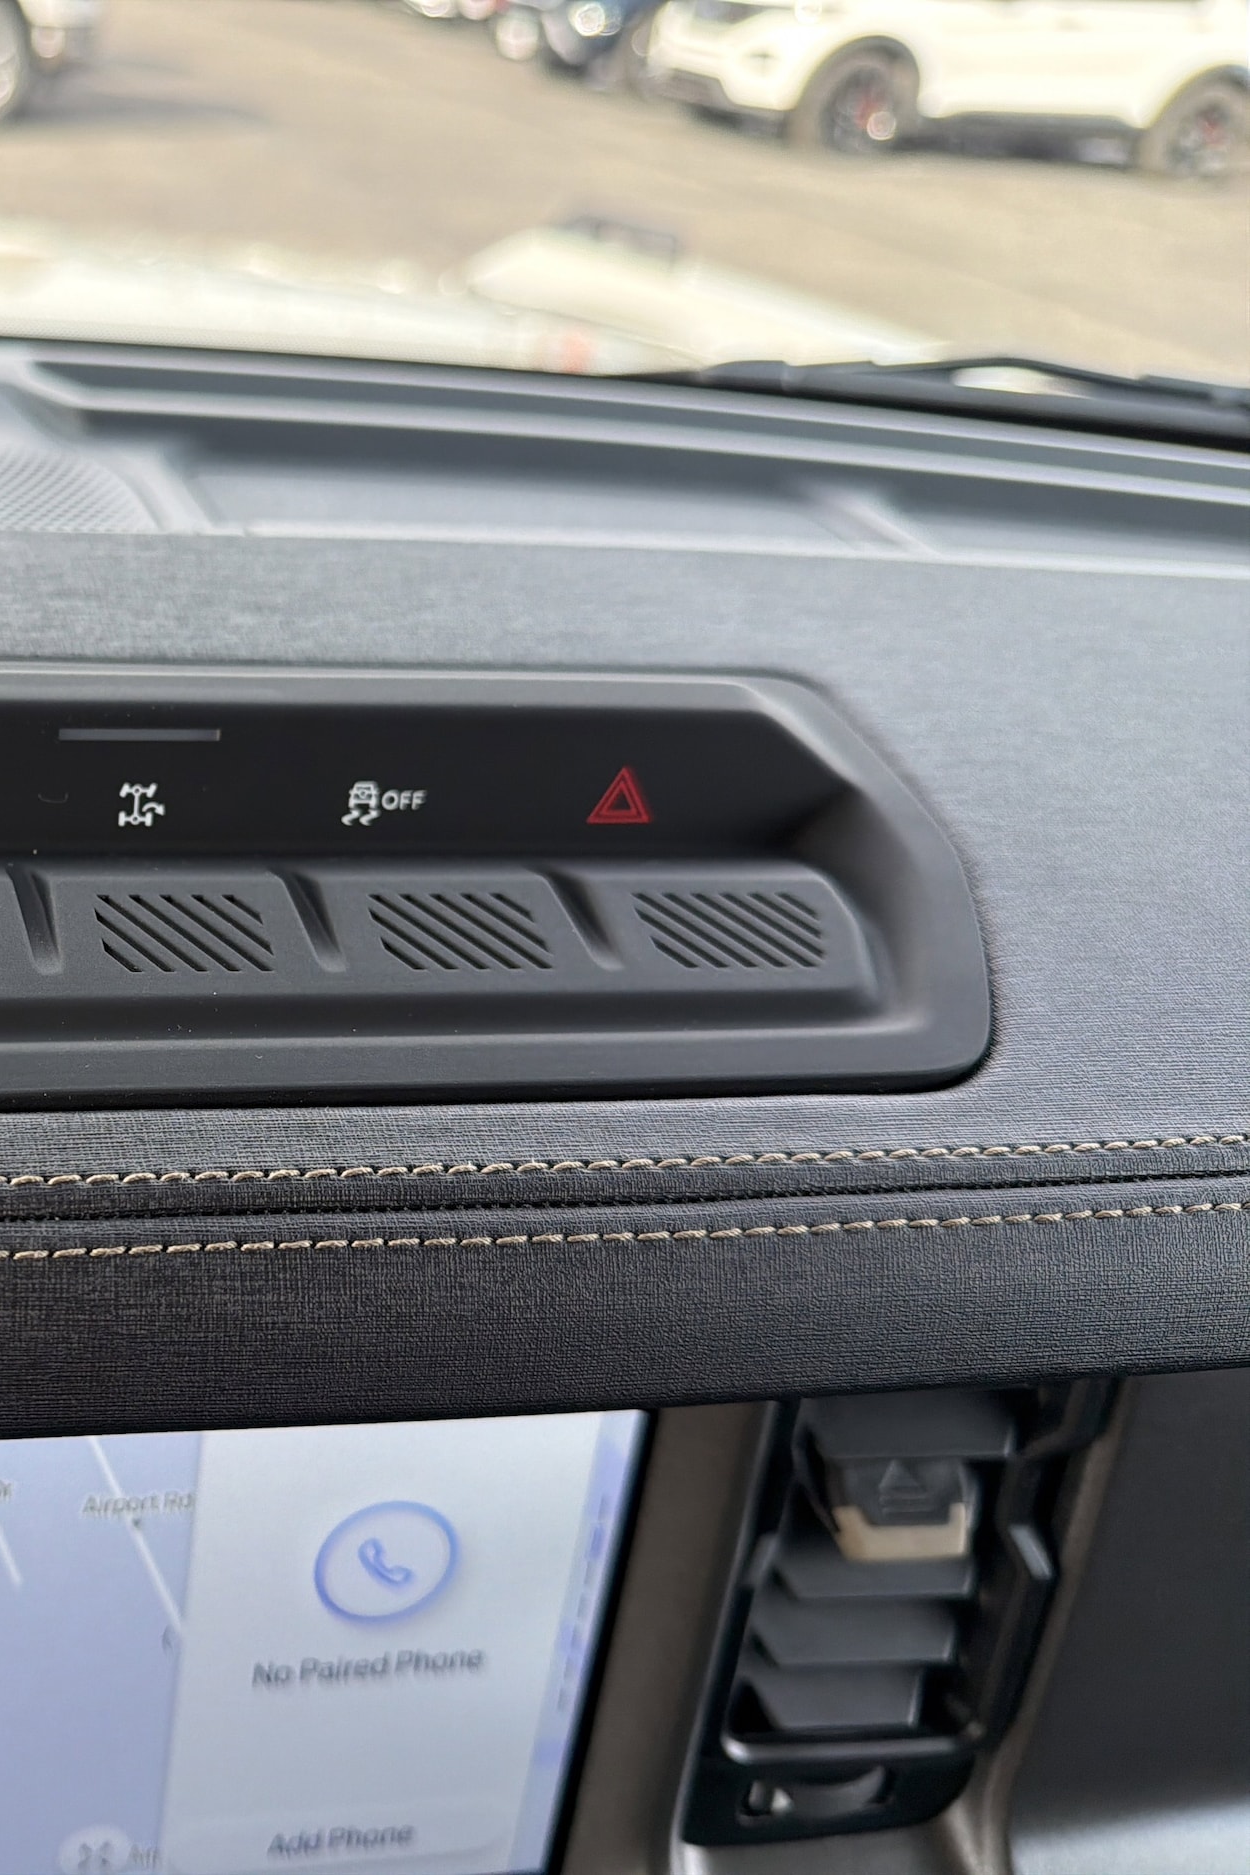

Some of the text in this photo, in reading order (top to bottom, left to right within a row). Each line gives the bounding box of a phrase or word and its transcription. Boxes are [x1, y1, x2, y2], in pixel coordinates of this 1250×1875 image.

[382, 789, 427, 811] OFF
[82, 1495, 159, 1517] Airport
[252, 1649, 483, 1685] No Paired Phone
[266, 1824, 415, 1860] Add Phone
